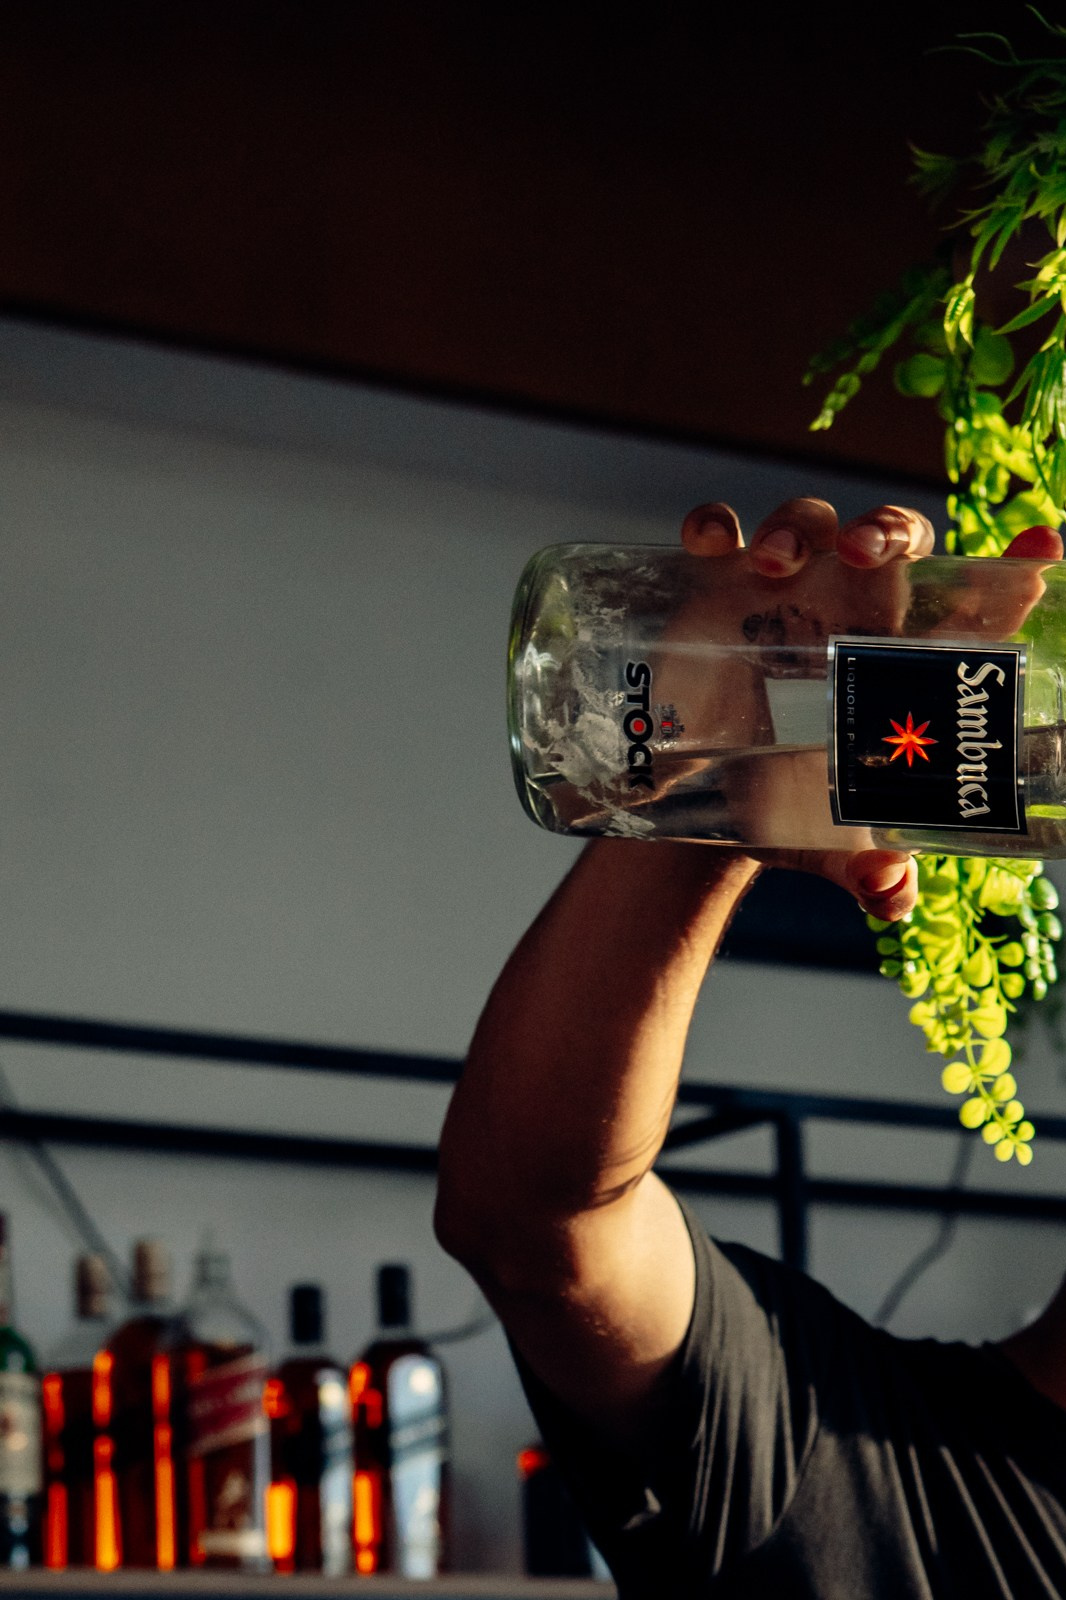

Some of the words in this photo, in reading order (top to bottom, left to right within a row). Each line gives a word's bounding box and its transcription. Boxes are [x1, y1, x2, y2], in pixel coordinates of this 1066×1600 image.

[623, 660, 655, 791] STOCK
[846, 656, 857, 725] LIQUORE
[956, 661, 1006, 818] Sambuca
